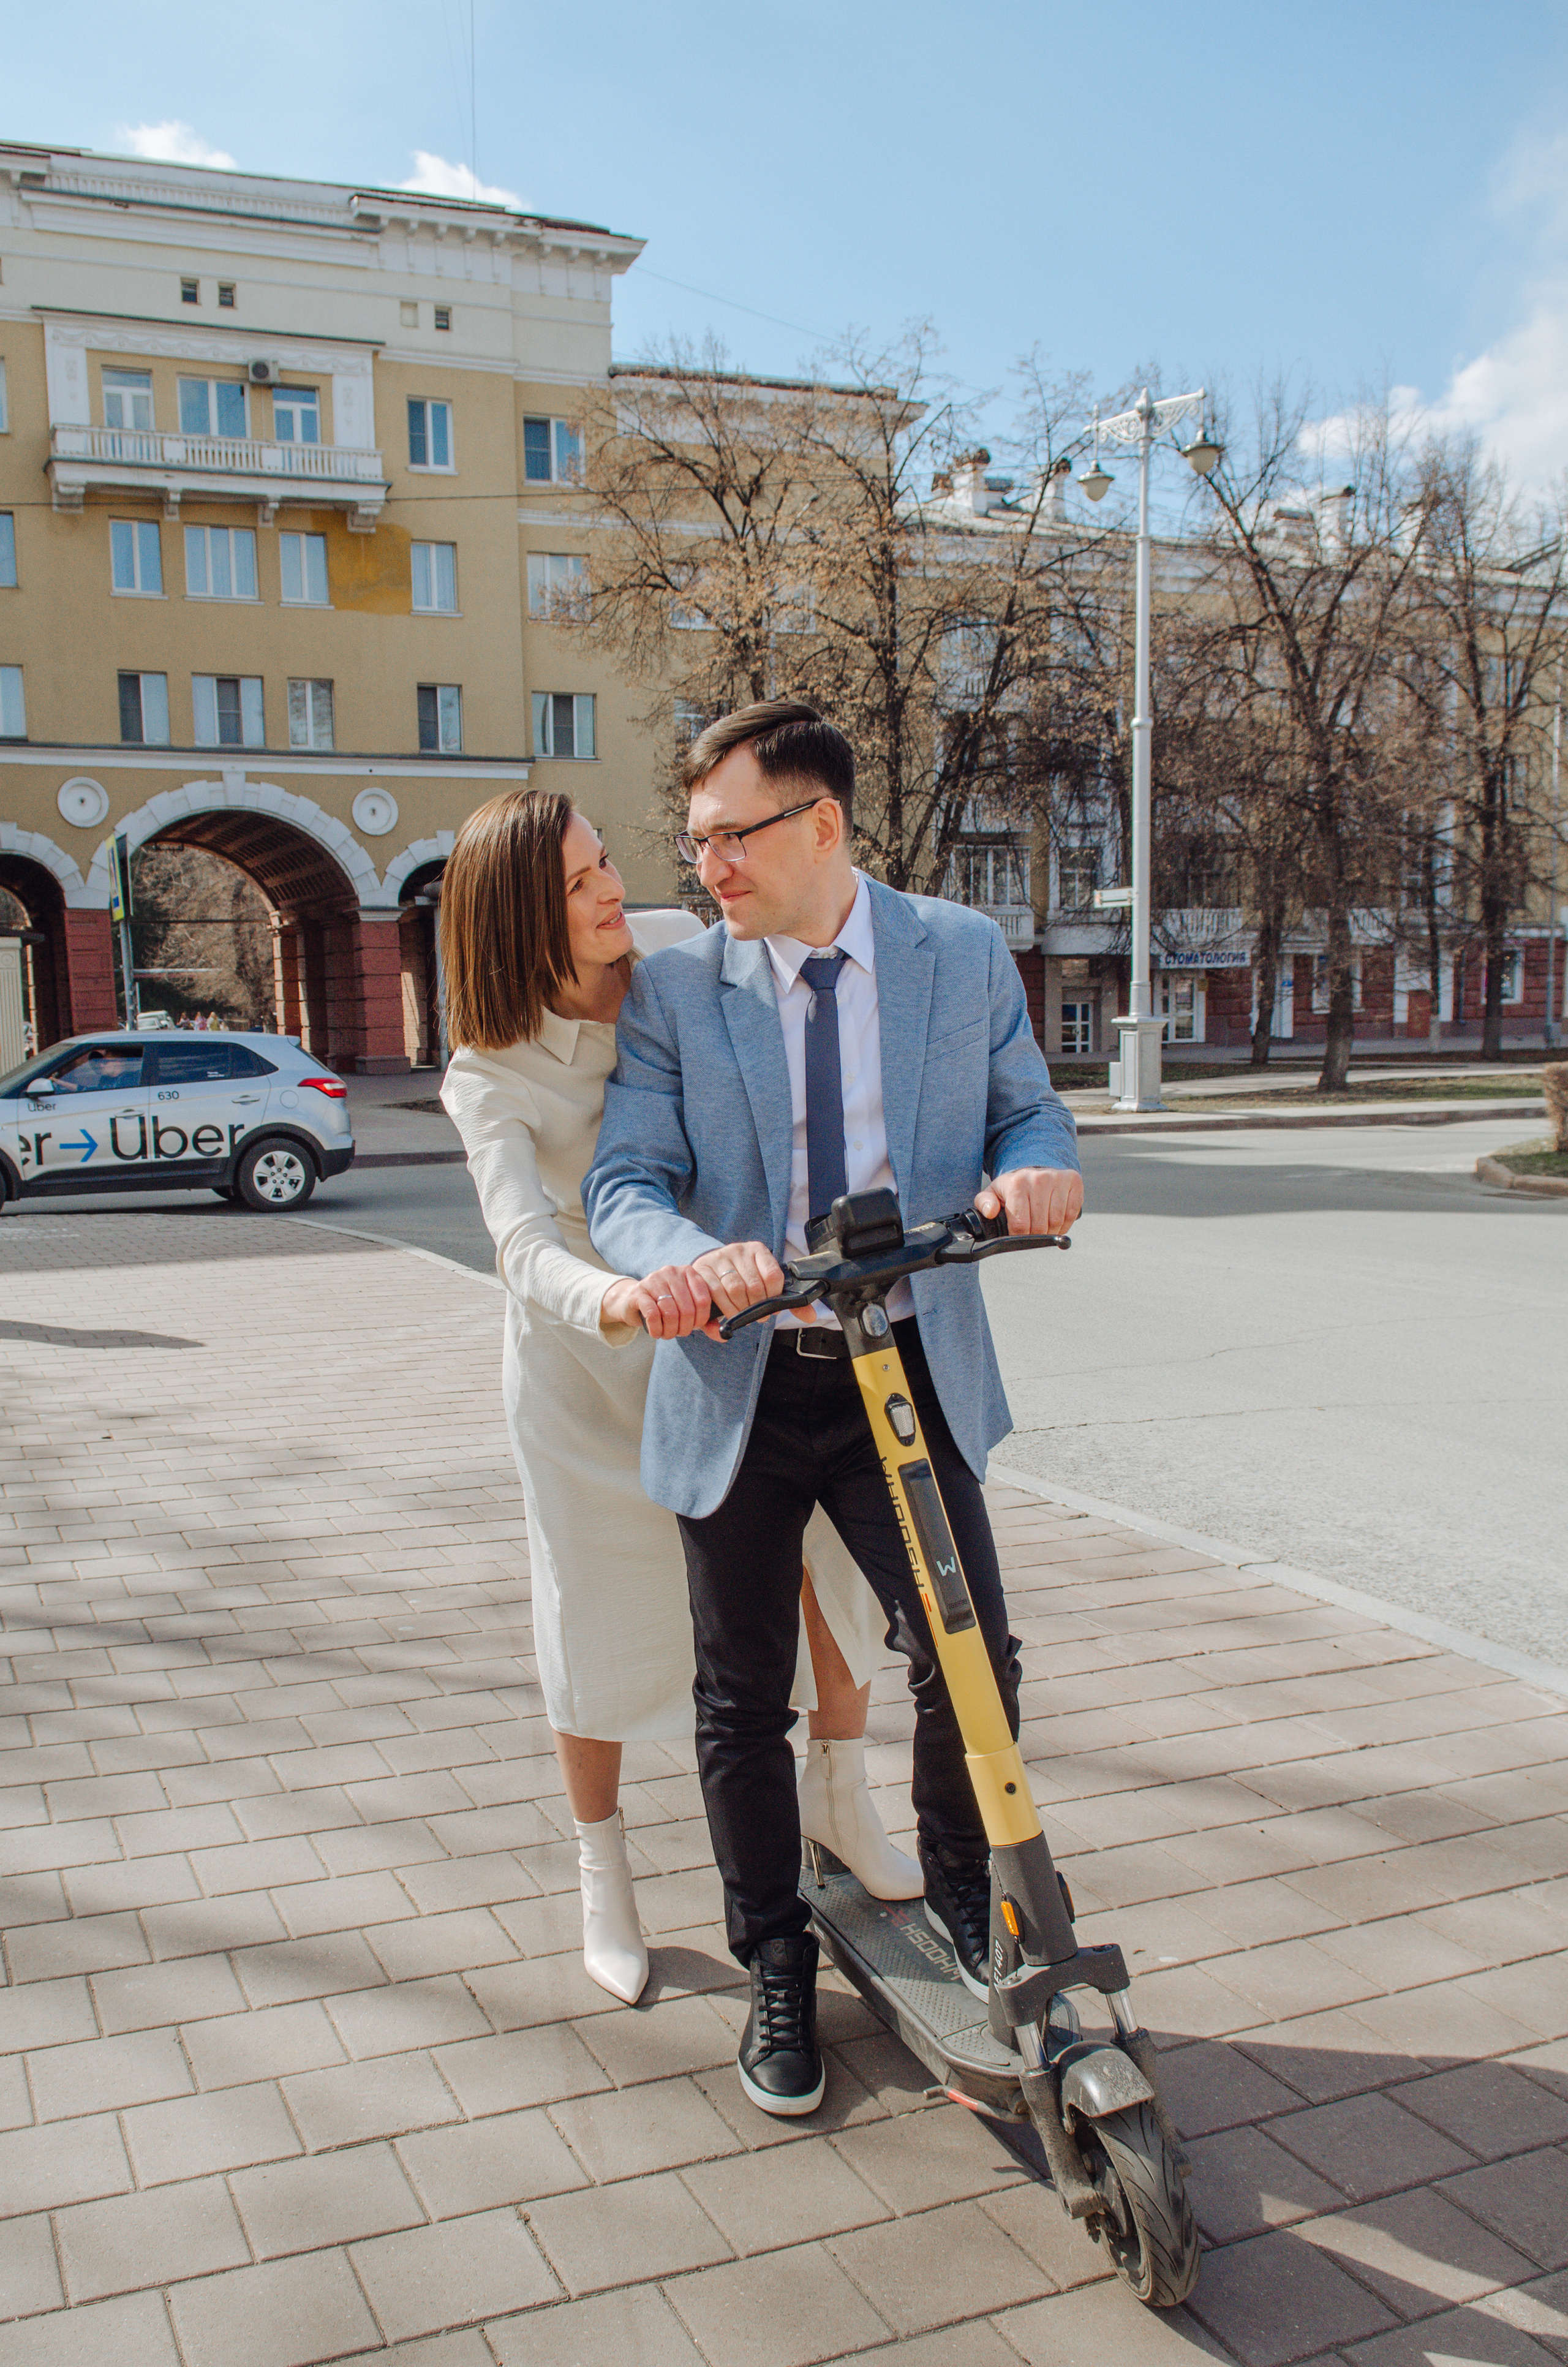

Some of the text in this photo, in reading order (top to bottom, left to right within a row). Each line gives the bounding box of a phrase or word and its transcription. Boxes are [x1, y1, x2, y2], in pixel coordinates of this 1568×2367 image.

[1165, 951, 1246, 965] СТОМАТОЛОГИЯ
[157, 1090, 179, 1101] 630
[28, 1101, 56, 1112] Uber
[110, 1116, 244, 1161] Uber
[900, 1922, 962, 1981] WHOOSH
